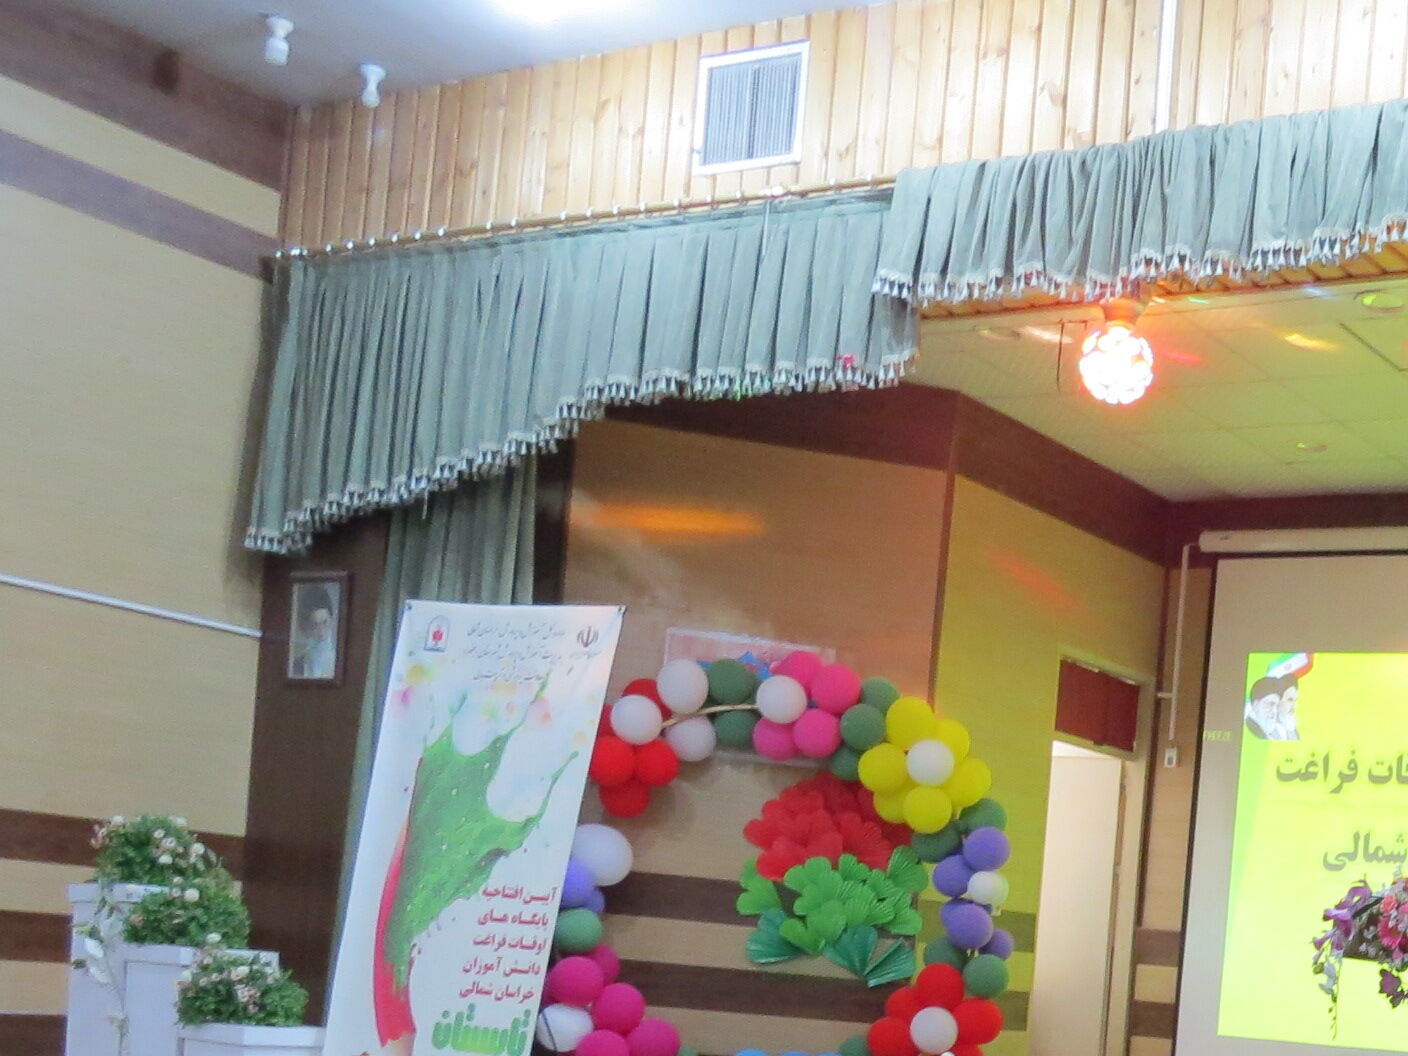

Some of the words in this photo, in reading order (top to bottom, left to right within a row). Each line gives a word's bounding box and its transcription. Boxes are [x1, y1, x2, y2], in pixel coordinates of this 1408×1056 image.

[1276, 749, 1359, 795] فراغت
[1322, 830, 1408, 871] شمالی
[473, 933, 506, 952] فراغت
[508, 935, 547, 956] اوقات
[462, 956, 503, 975] آموزان
[503, 959, 541, 977] دانش
[459, 980, 493, 998] شمالی
[494, 983, 534, 1003] خراسان
